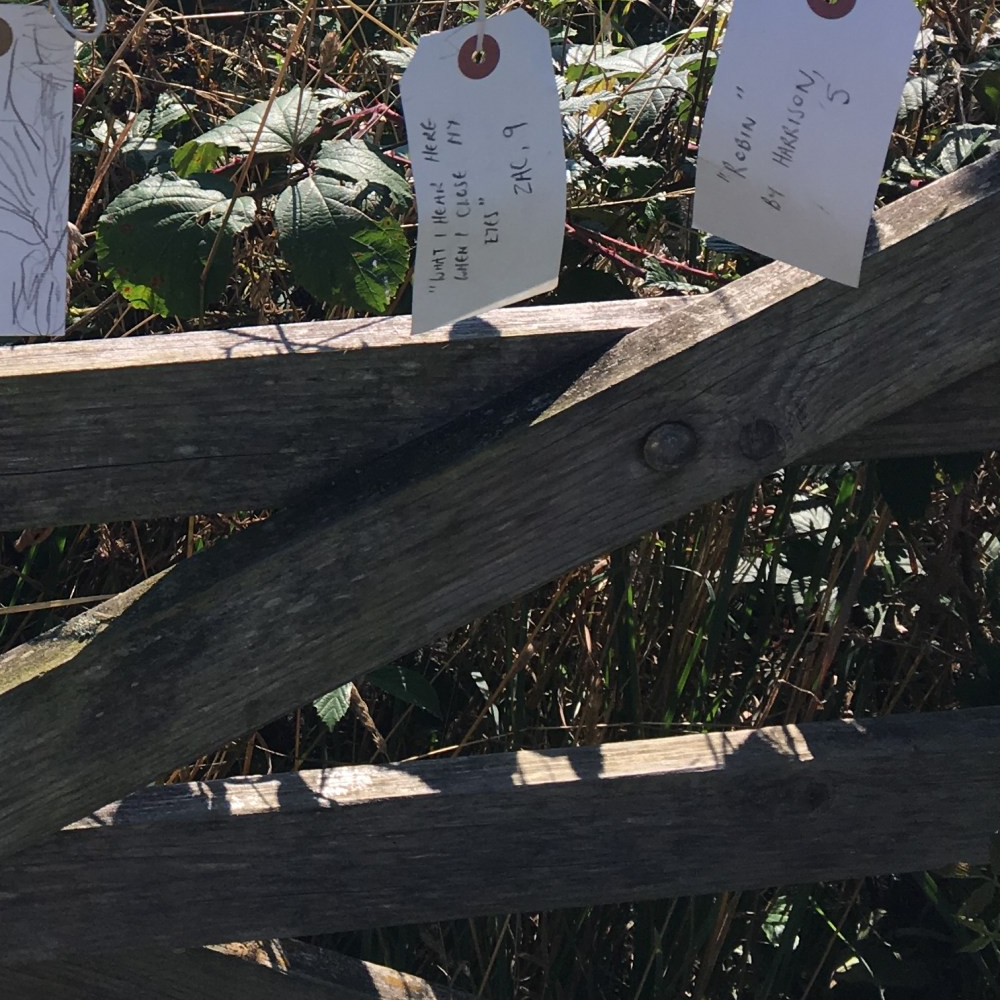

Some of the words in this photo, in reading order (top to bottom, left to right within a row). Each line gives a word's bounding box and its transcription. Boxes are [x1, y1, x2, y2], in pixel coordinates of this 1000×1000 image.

[826, 83, 851, 105] 5
[420, 118, 440, 163] HERE
[447, 120, 463, 145] MY
[502, 122, 528, 138] 9
[430, 182, 447, 224] HEAR
[455, 170, 471, 218] CLOSE
[761, 187, 784, 211] BY
[454, 246, 469, 281] WHEN
